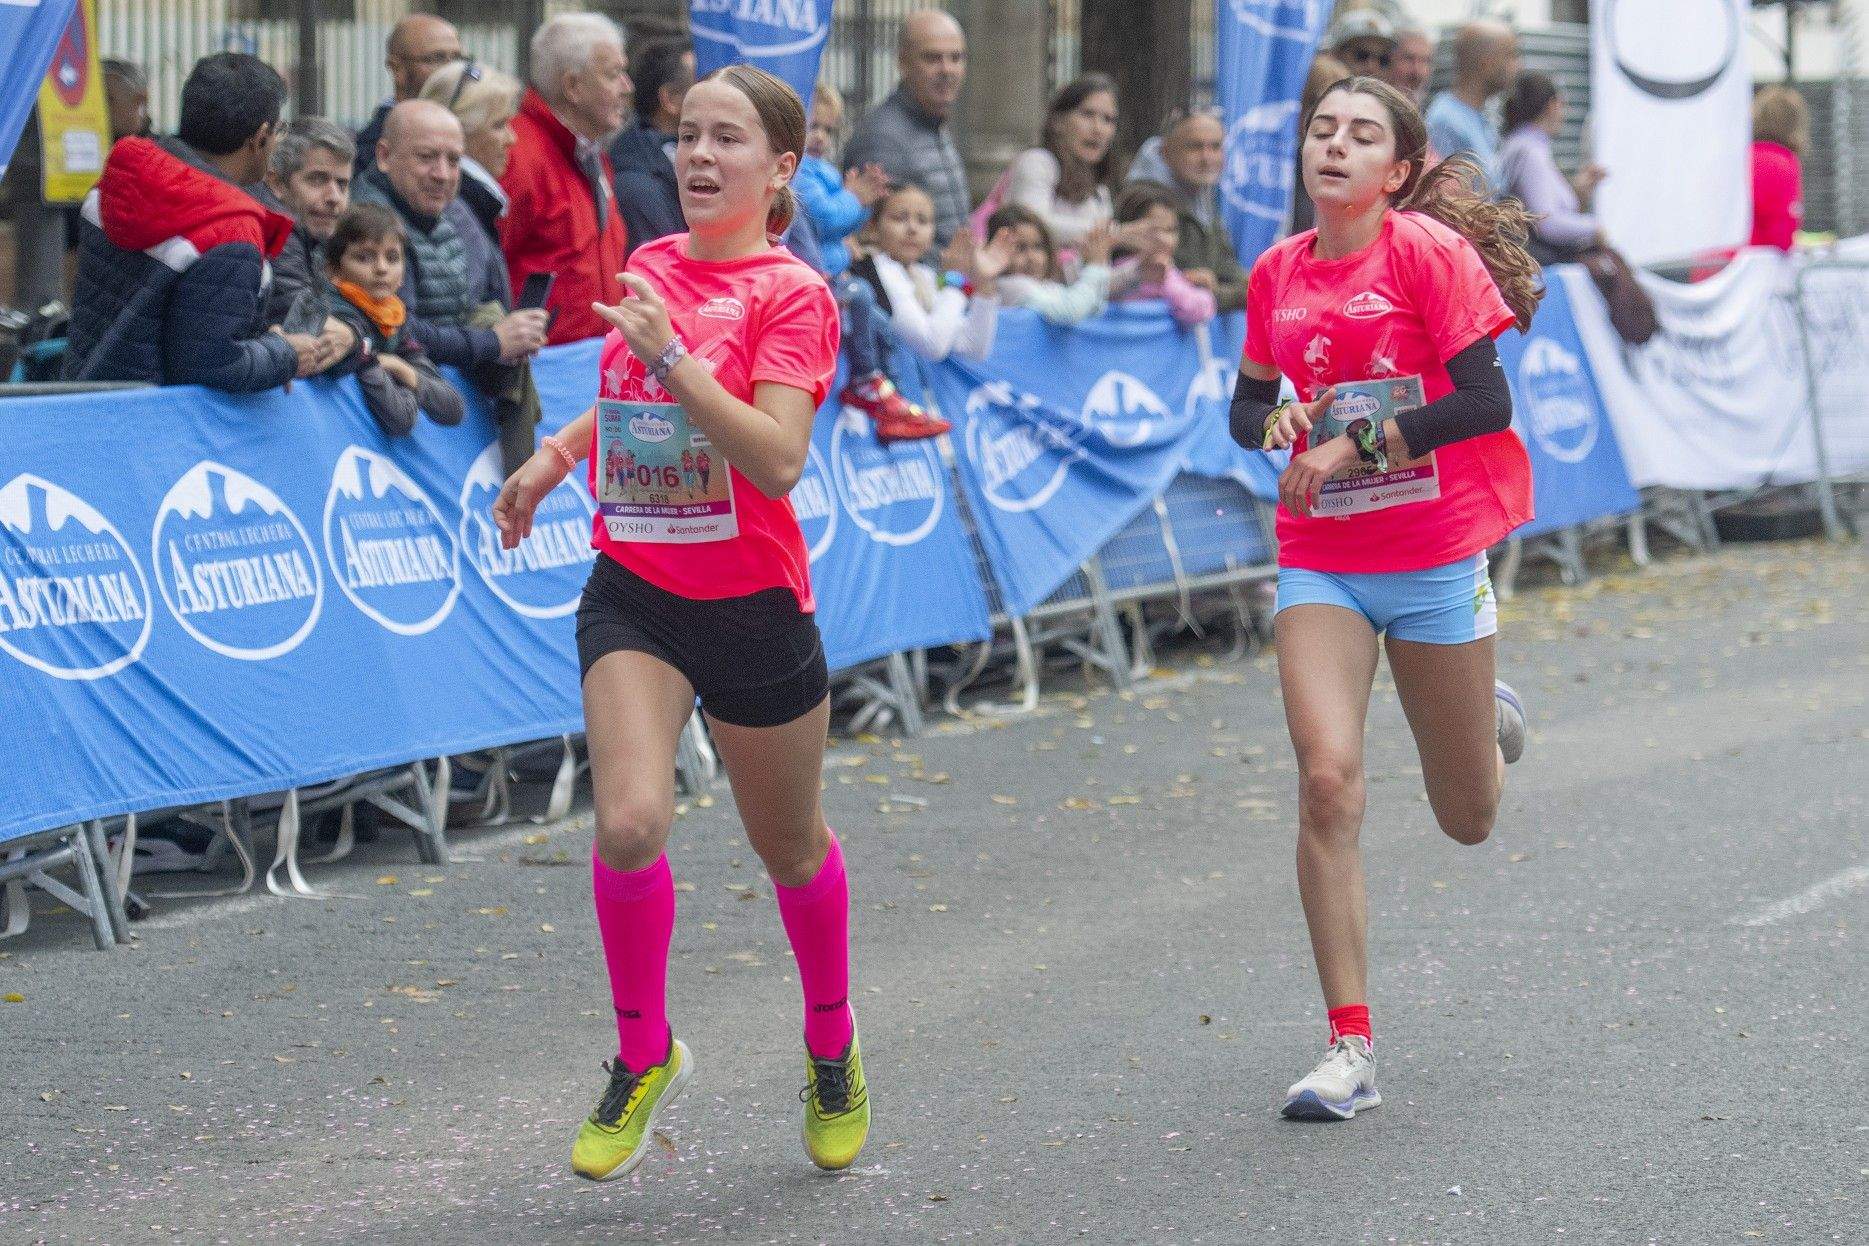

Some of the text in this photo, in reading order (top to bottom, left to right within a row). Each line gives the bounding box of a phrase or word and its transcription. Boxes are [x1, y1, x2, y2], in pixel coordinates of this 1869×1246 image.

[1273, 308, 1307, 322] YSHO
[637, 464, 680, 488] 016
[1343, 481, 1352, 489] DE
[1352, 480, 1361, 488] LA
[1389, 470, 1416, 482] SEVILLA
[1321, 486, 1423, 510] OYSHO Santander
[615, 505, 644, 514] CARRERA
[645, 506, 652, 514] DE
[652, 506, 660, 514] LA
[683, 505, 712, 515] SEVILLA
[609, 521, 719, 535] OYSHO Santander
[184, 530, 239, 552] CENTRAL
[5, 541, 119, 566] CETRAL LECHERA
[168, 539, 316, 615] ASTURIANA
